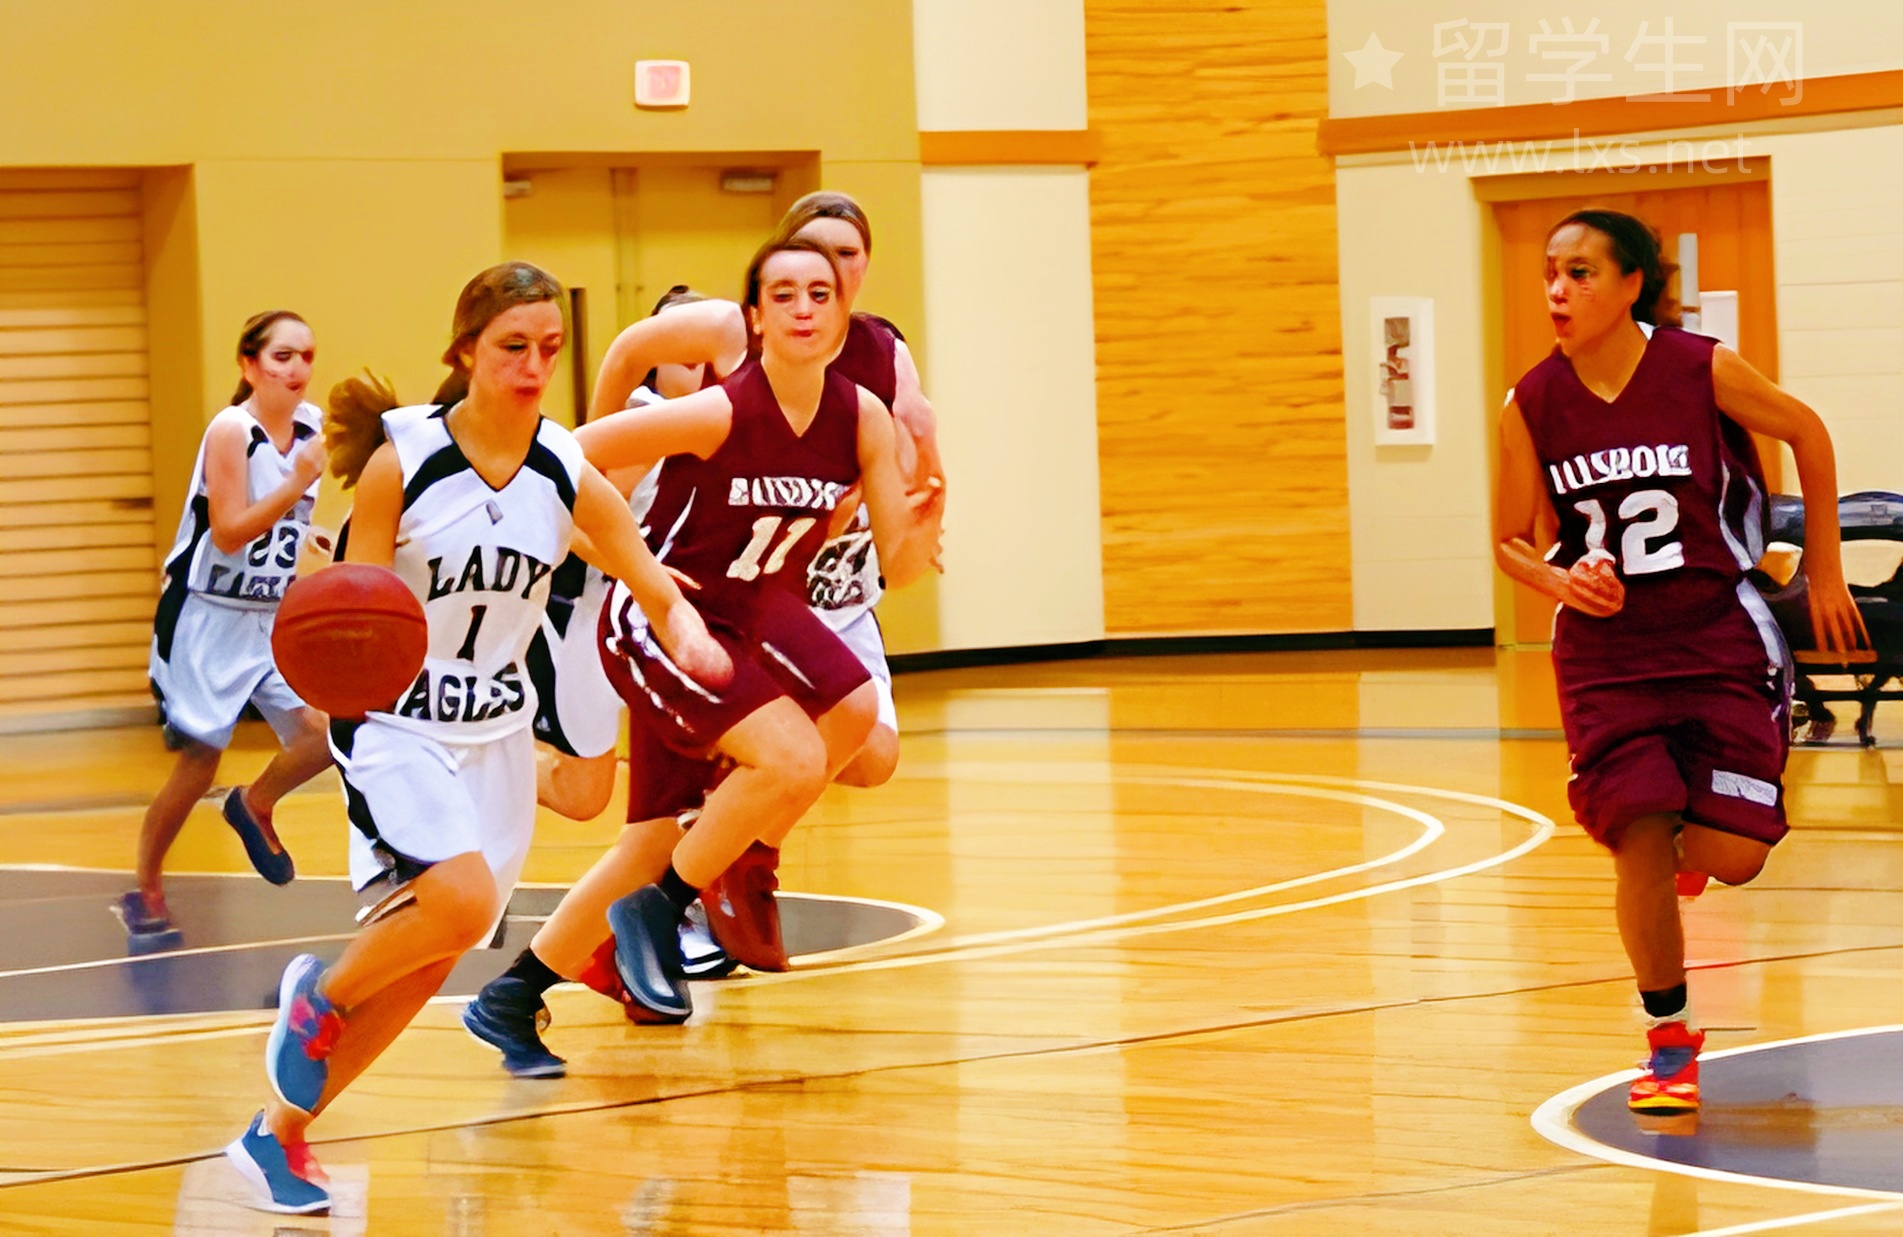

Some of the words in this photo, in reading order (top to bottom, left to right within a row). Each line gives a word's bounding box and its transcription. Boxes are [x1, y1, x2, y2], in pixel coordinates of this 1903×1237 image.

[726, 515, 817, 582] 11
[1573, 489, 1685, 576] 12
[427, 545, 552, 602] LADY
[456, 604, 488, 661] 1
